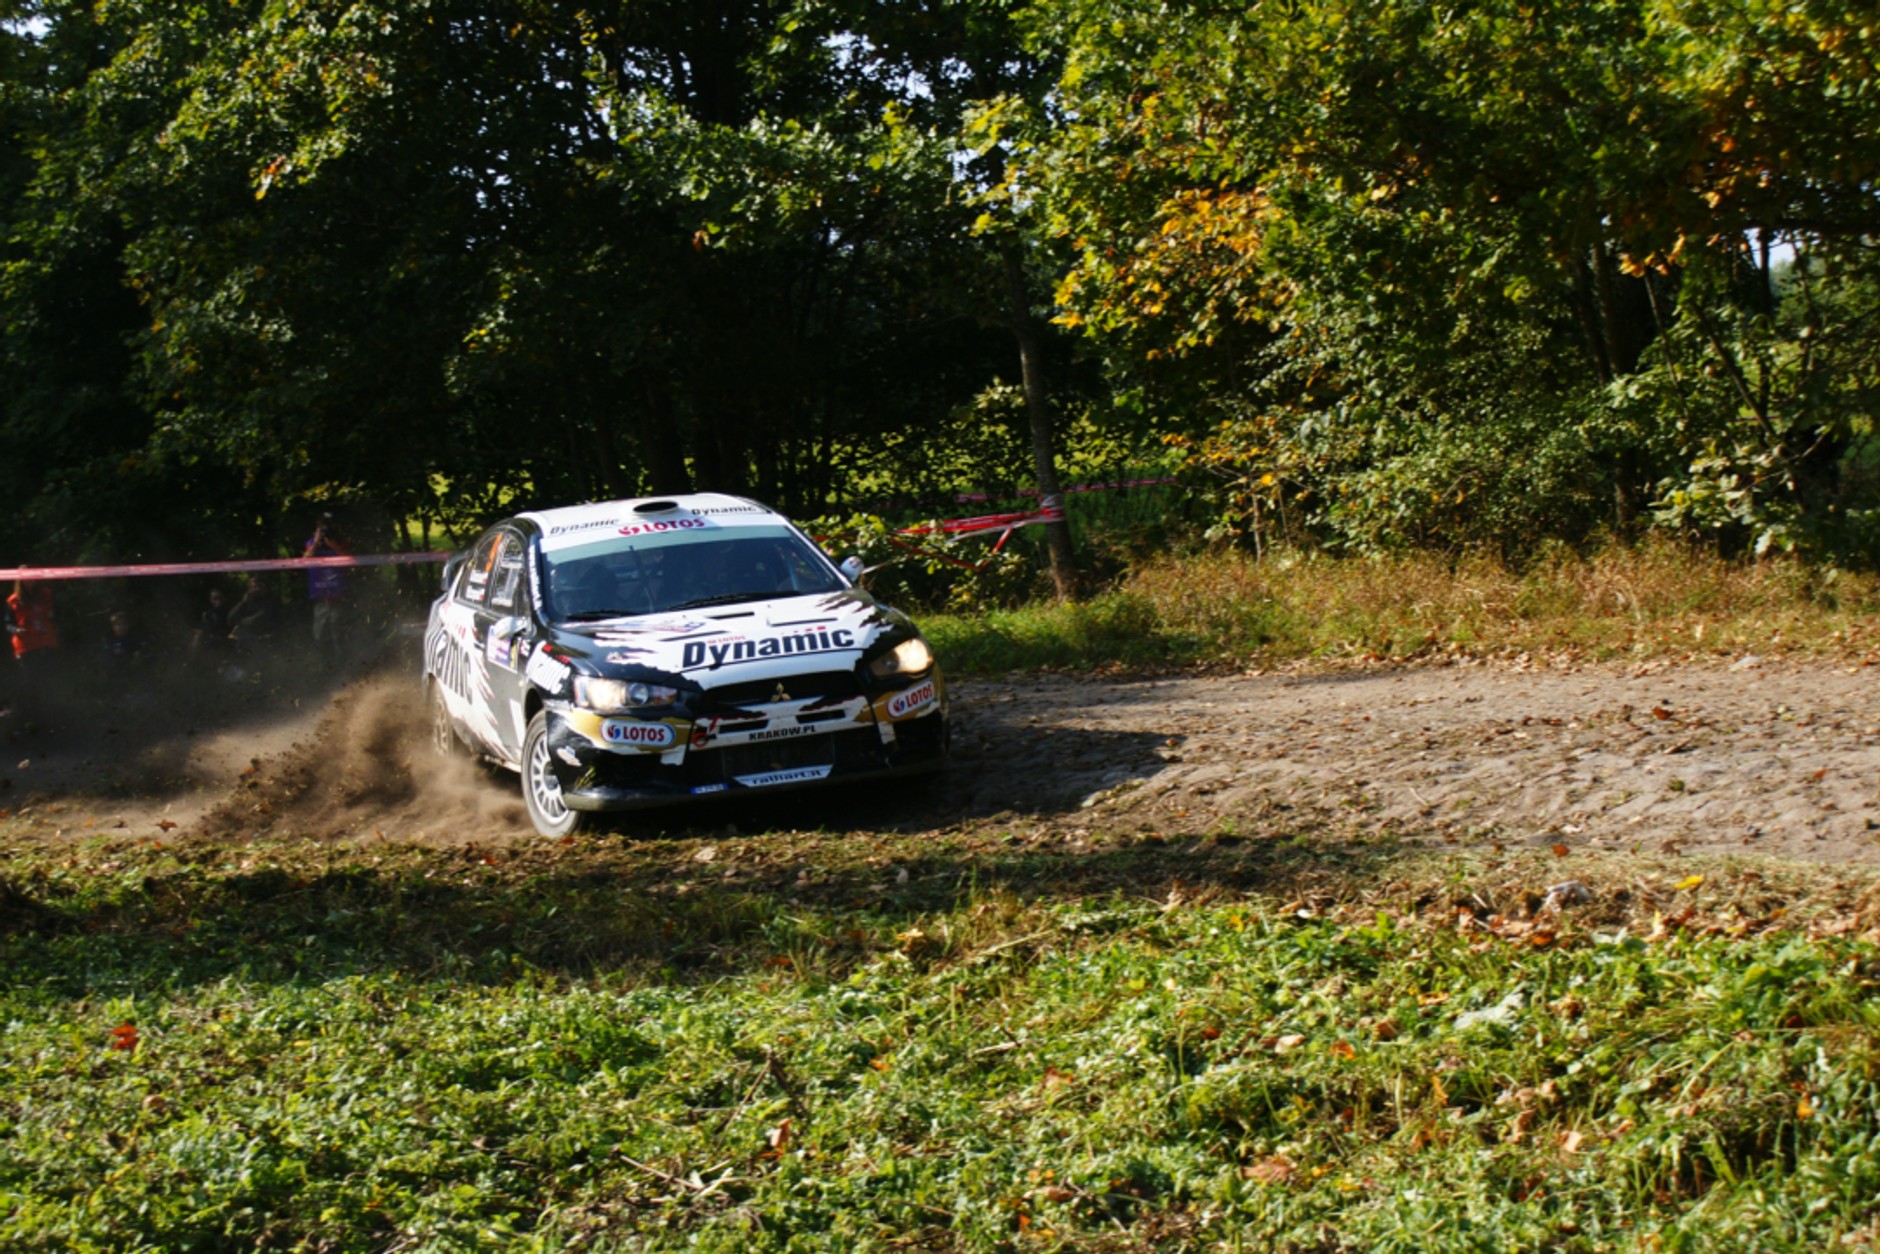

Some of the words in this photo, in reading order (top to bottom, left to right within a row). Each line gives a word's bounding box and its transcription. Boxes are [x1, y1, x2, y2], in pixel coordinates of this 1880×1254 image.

[550, 519, 619, 534] Dynamic
[644, 518, 705, 532] LOTOS
[682, 626, 855, 671] Dynamic
[905, 683, 933, 708] LOTOS
[623, 726, 665, 742] LOTOS
